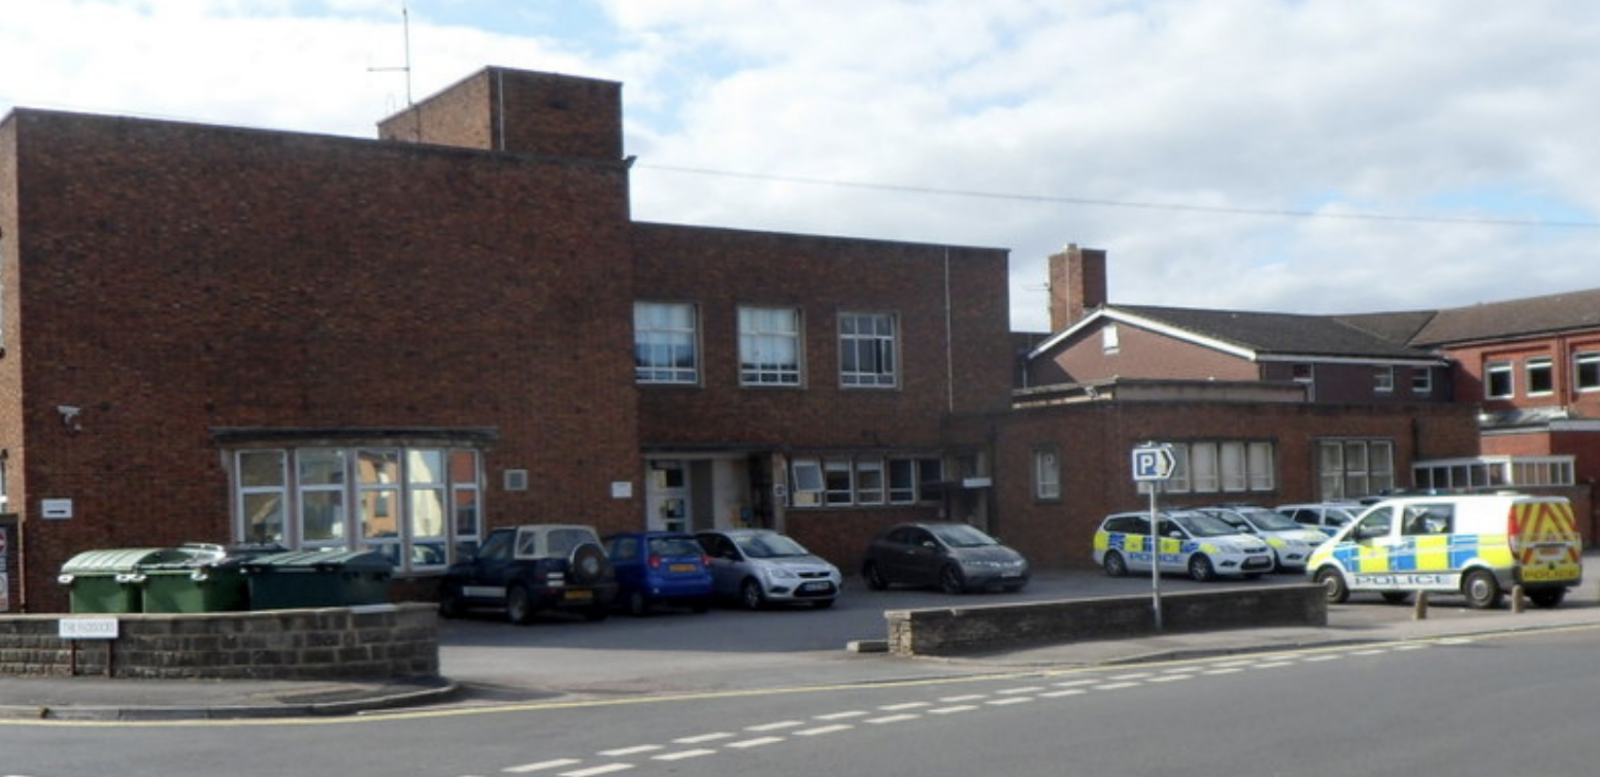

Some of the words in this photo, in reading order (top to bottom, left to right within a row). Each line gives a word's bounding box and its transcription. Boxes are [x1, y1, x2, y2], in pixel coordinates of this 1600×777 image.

[1140, 454, 1154, 475] P
[1524, 570, 1578, 578] POLICE
[1355, 575, 1450, 585] POLICE
